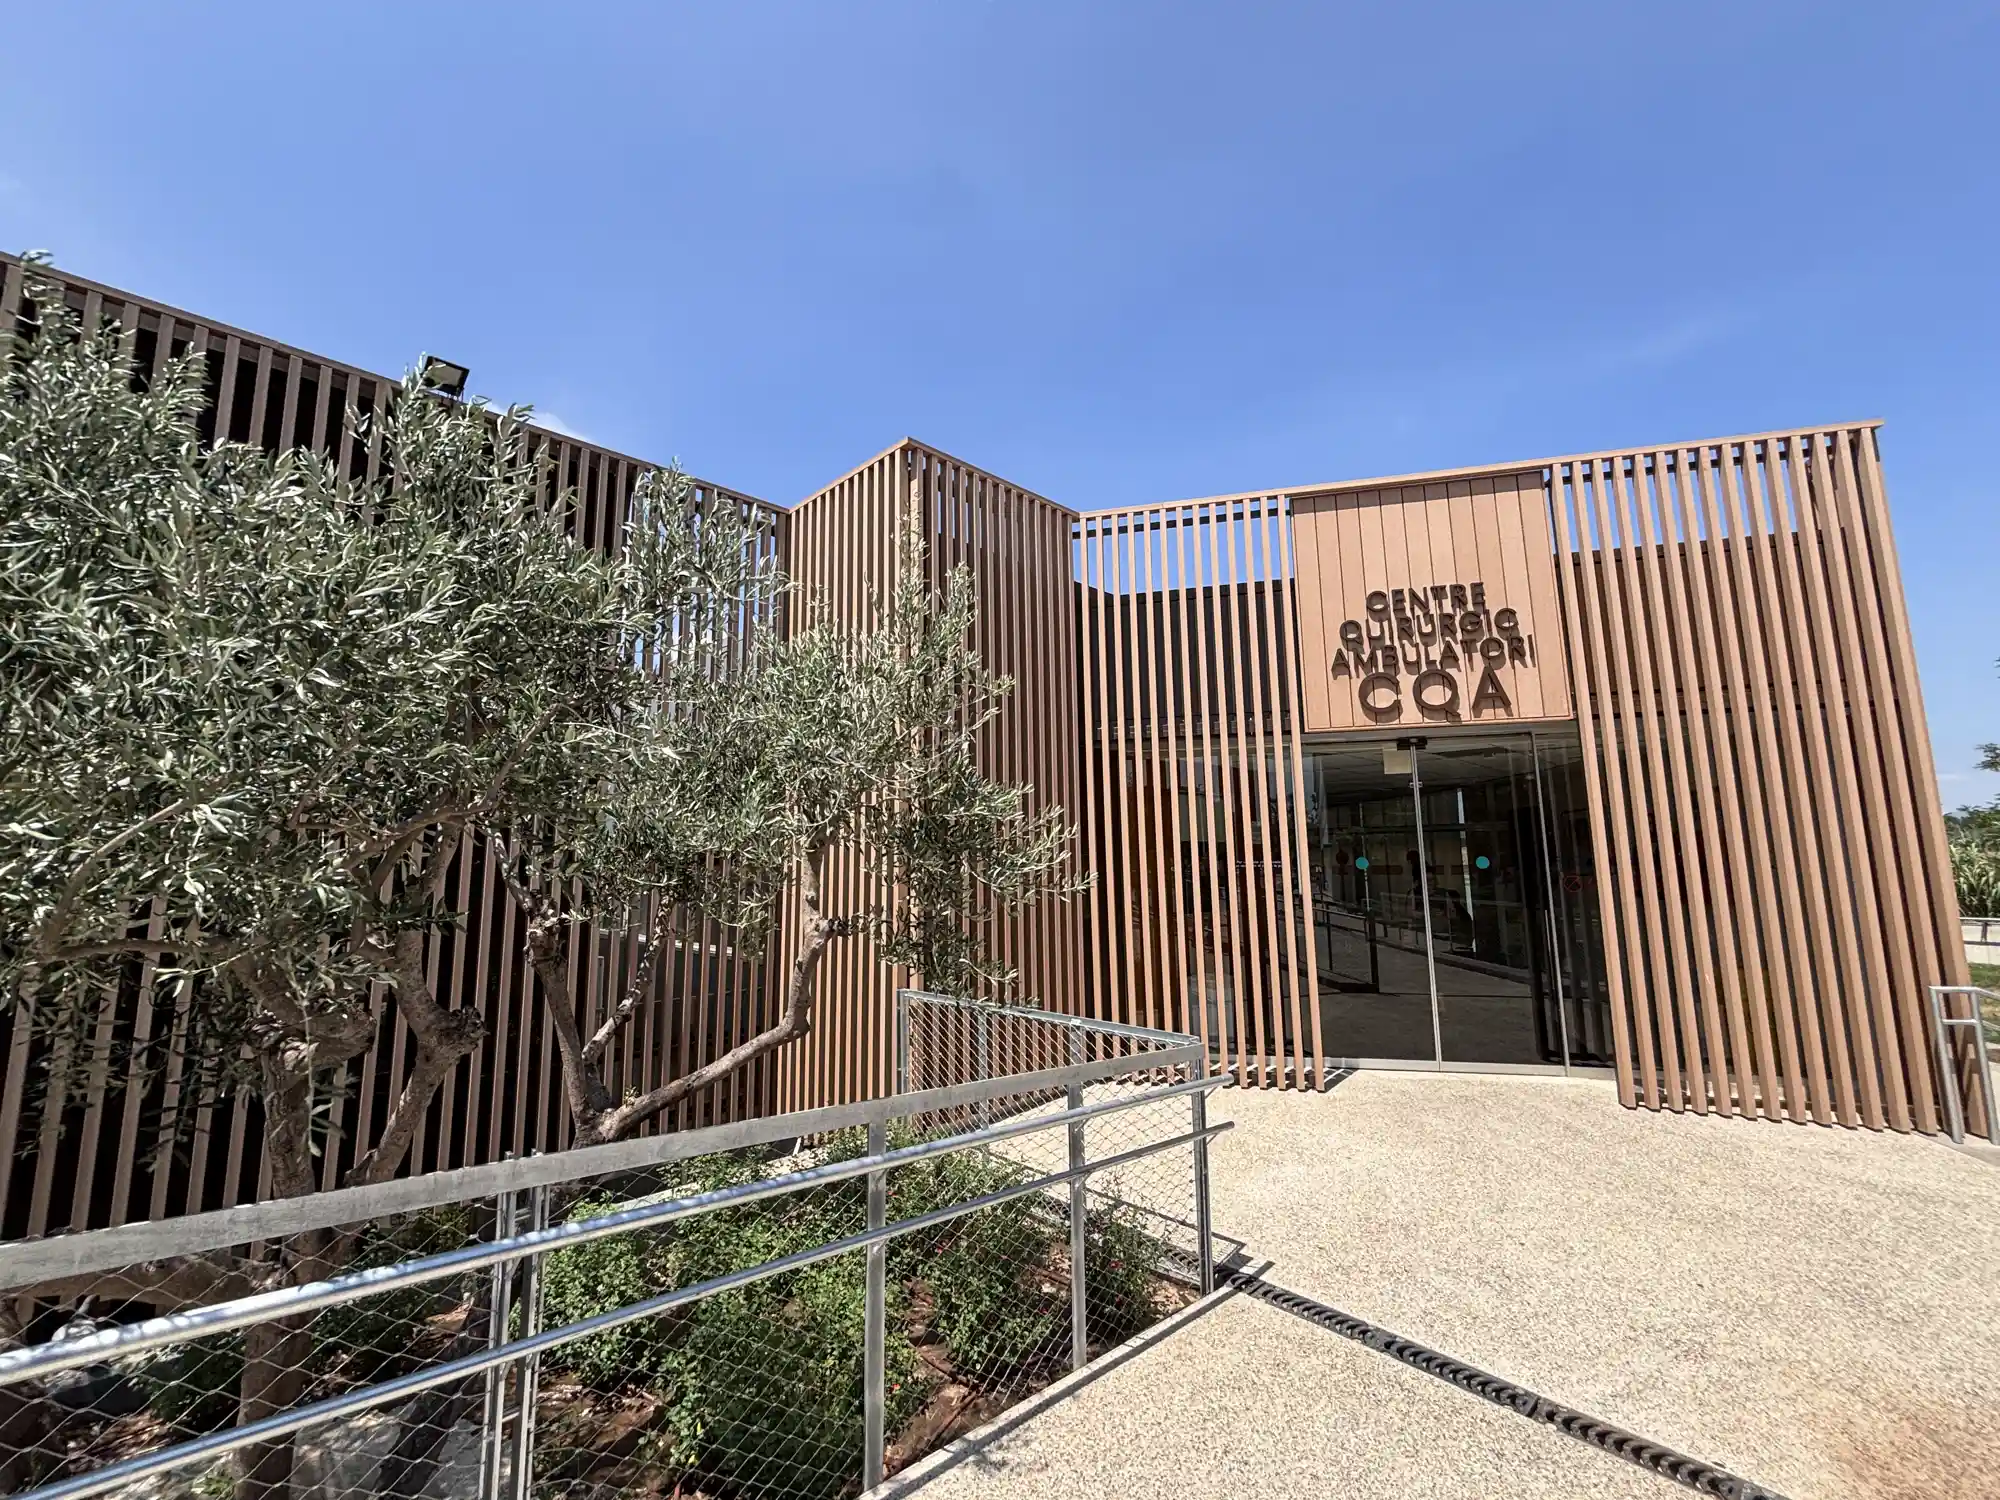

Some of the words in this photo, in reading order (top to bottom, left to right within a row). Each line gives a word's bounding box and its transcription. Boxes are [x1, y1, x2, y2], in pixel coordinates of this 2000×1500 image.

[1366, 582, 1486, 613] CENTRE
[1339, 608, 1519, 644] QUIRURGIC
[1331, 634, 1536, 672] AMBULATORI
[1358, 665, 1512, 718] CQA
